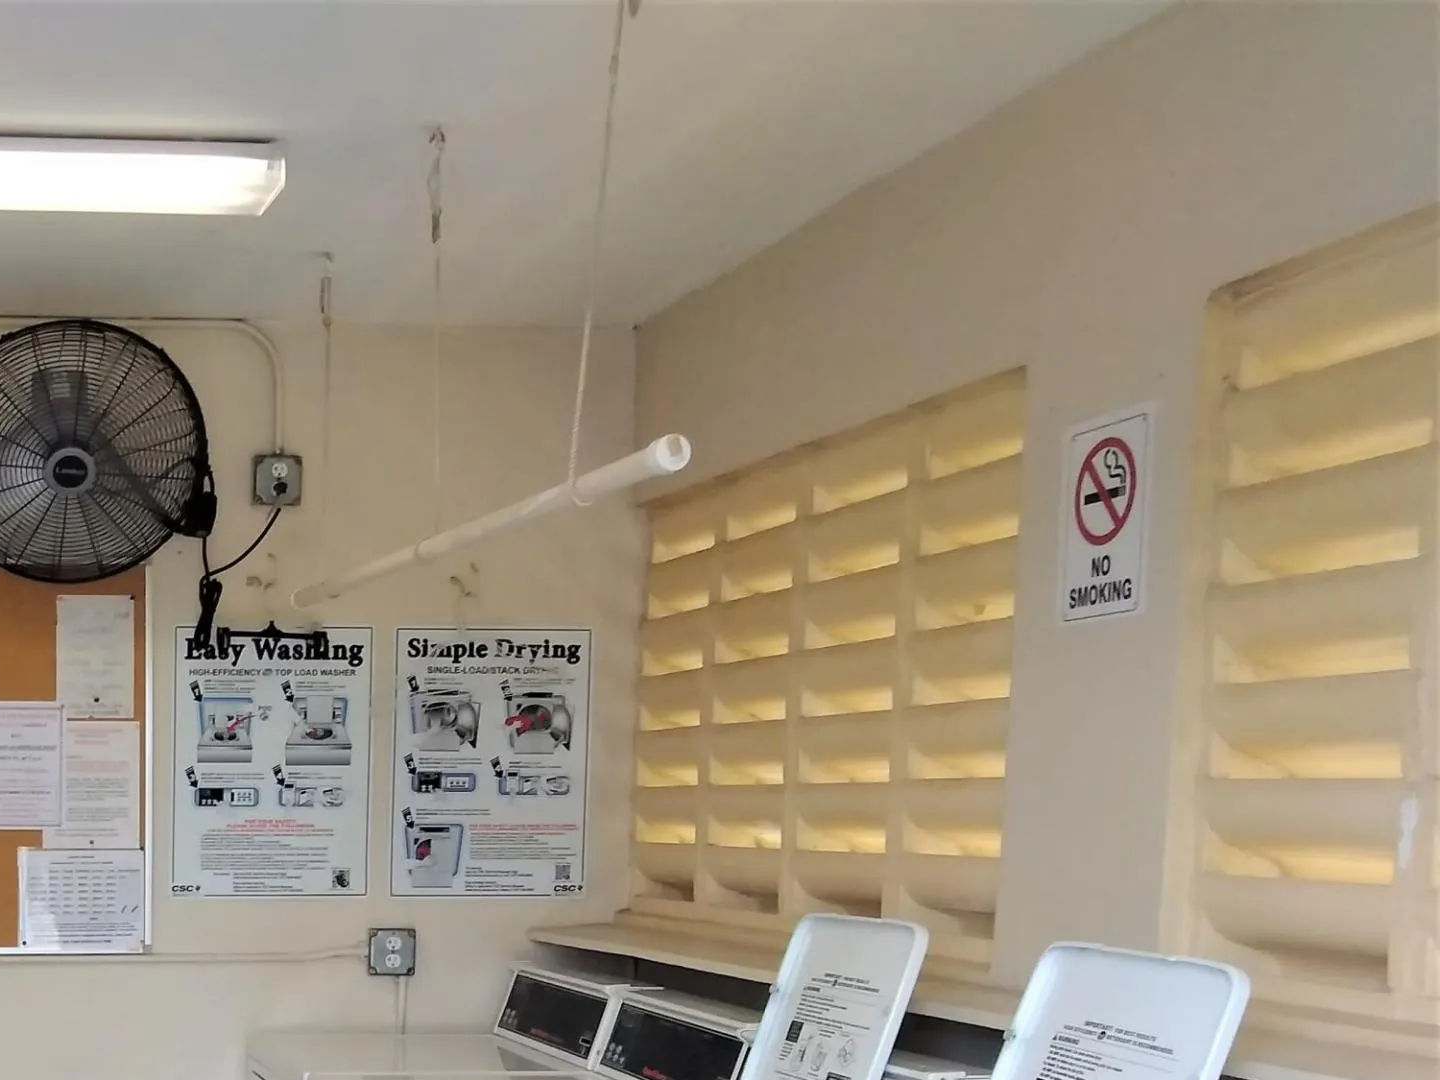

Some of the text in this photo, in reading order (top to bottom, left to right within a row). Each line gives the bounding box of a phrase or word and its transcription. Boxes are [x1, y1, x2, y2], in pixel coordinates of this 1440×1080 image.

[1090, 554, 1111, 578] NO
[1068, 578, 1133, 610] SMOKING
[408, 637, 582, 665] Simple Drying
[189, 668, 357, 677] HIGH-EFFICIENCY TOP LOAD WASHER
[171, 884, 194, 893] CSC
[553, 884, 577, 893] CSC
